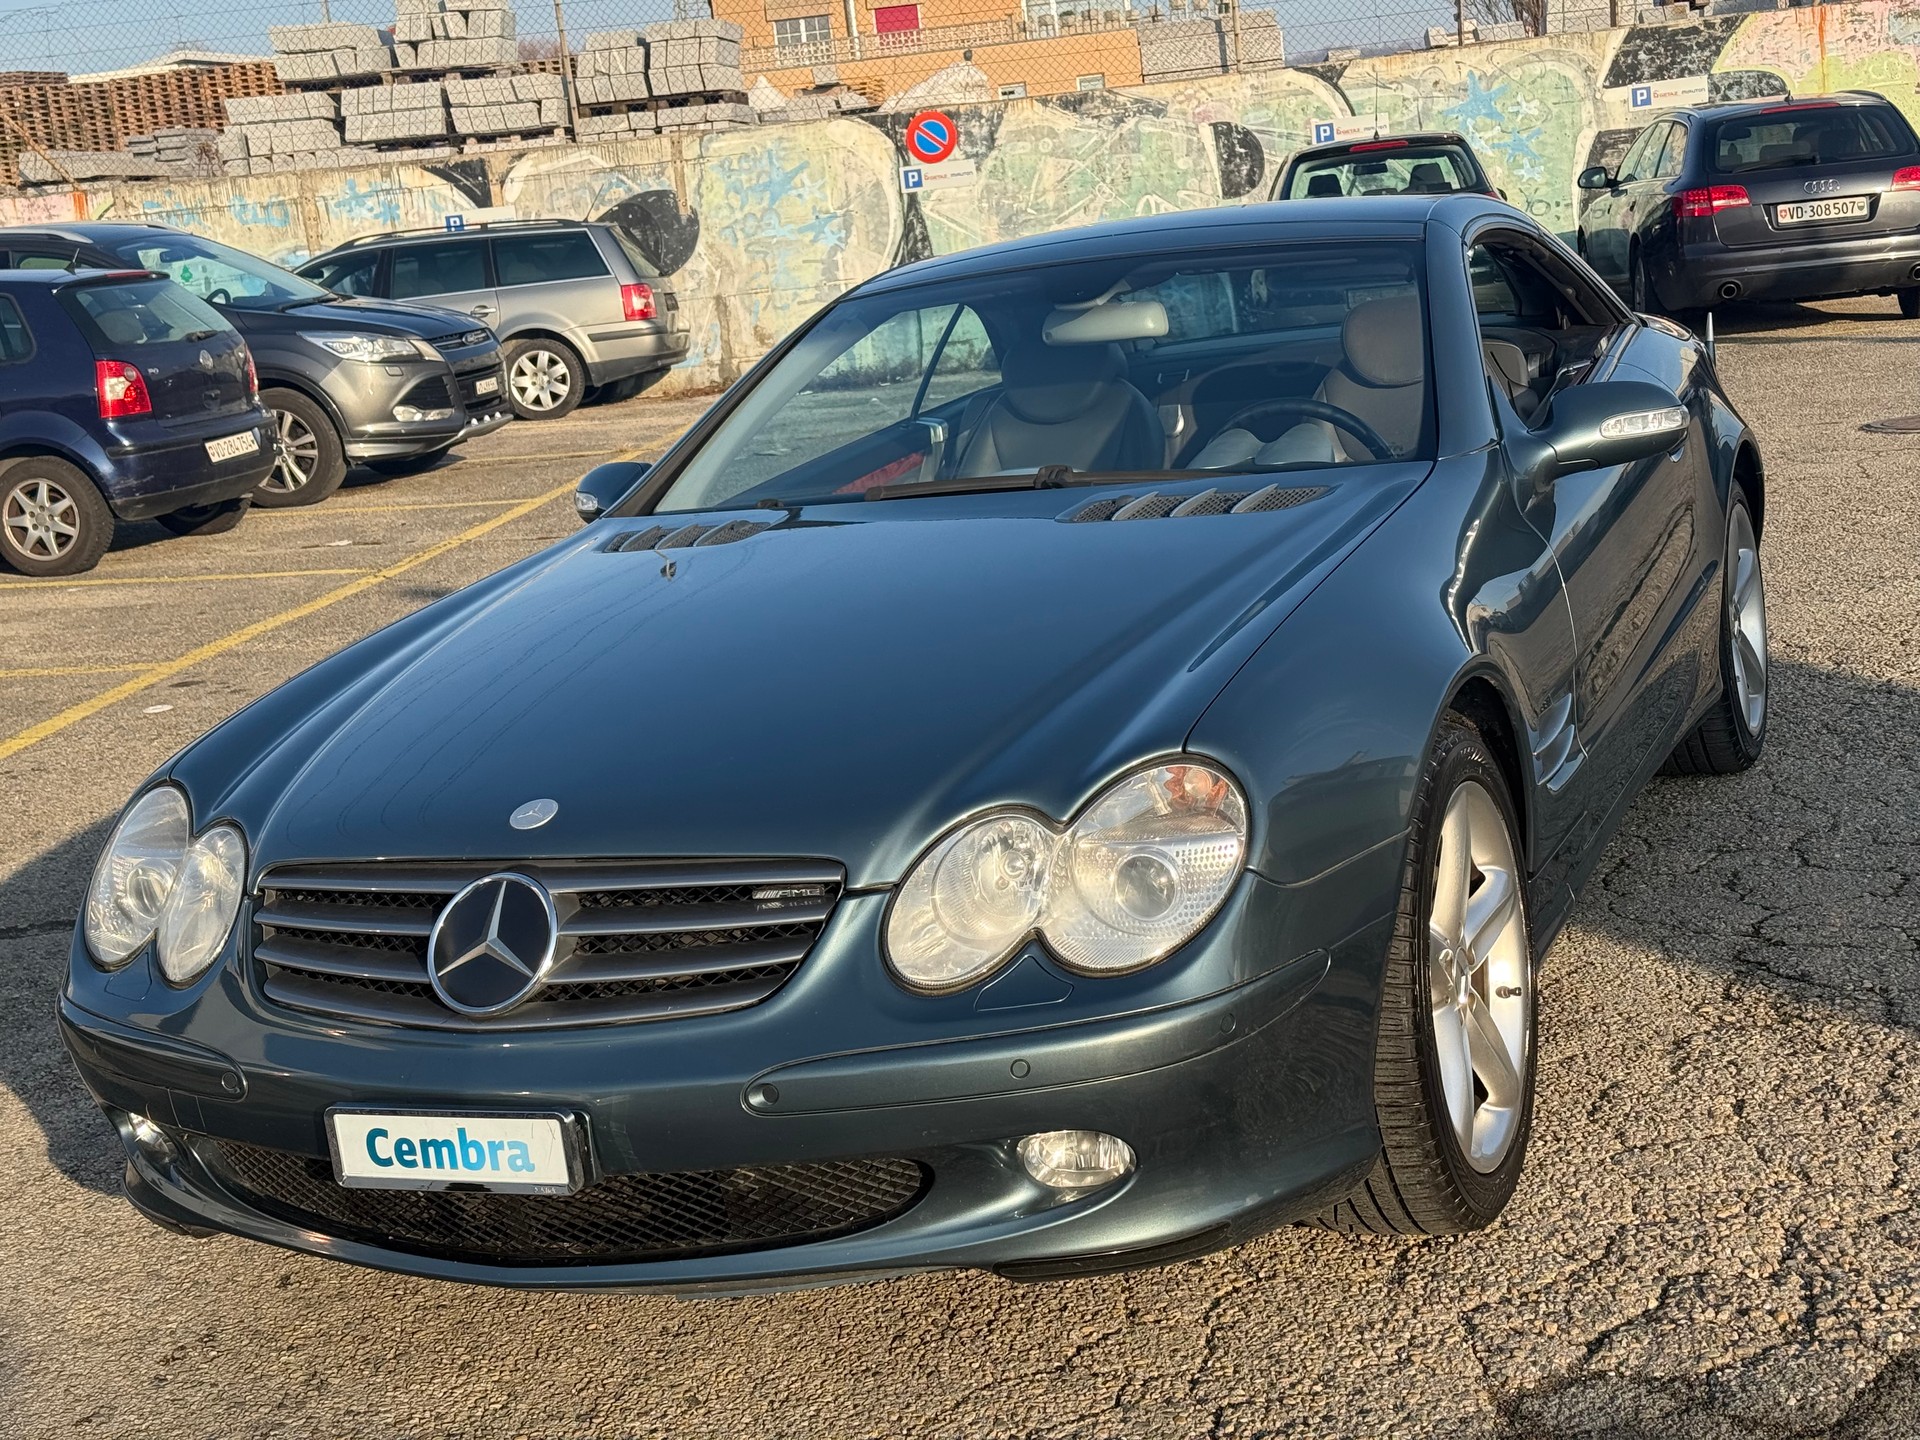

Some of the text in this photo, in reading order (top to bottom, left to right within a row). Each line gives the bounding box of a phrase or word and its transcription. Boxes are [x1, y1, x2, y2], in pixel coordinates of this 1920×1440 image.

[1636, 89, 1647, 105] P
[1320, 126, 1330, 141] P
[908, 171, 918, 187] P
[366, 1127, 535, 1173] Cembra
